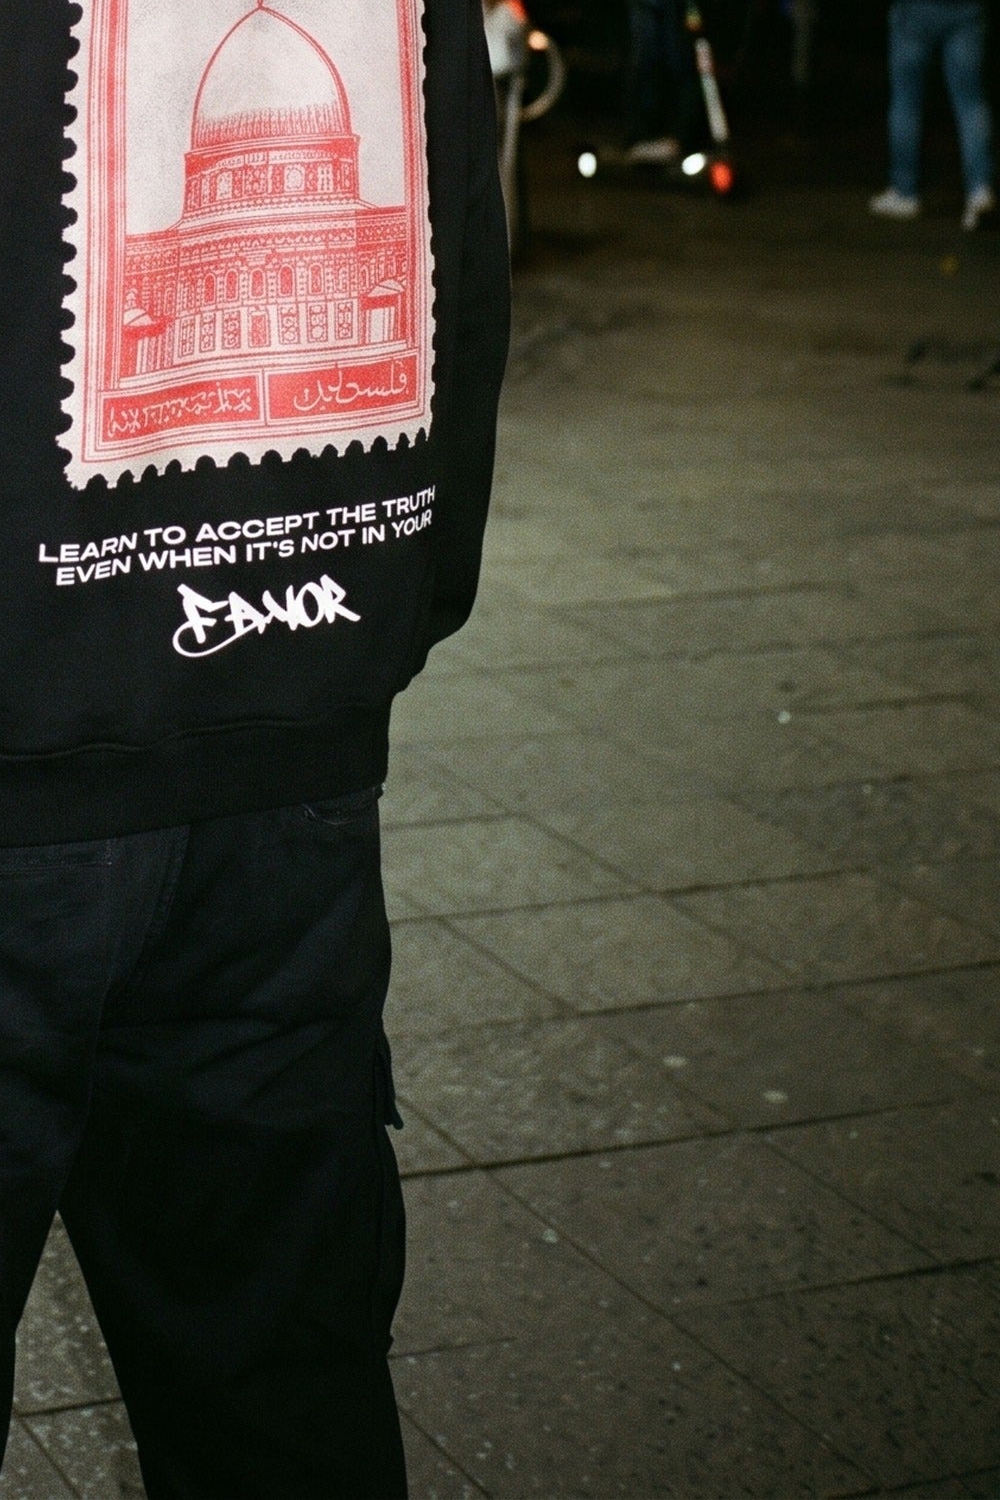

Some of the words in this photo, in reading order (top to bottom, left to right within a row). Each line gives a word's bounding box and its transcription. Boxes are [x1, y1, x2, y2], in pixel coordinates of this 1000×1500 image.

[38, 532, 138, 563] LEARN
[144, 525, 187, 547] TO
[195, 511, 321, 543] ACCEPT
[326, 502, 377, 526] THE
[381, 485, 436, 518] TRUTH
[55, 555, 132, 586] EVEN
[138, 544, 237, 572] WHEN
[246, 538, 295, 563] IT'S
[300, 528, 357, 554] NOT
[361, 523, 386, 545] IN
[391, 508, 433, 539] YOUR
